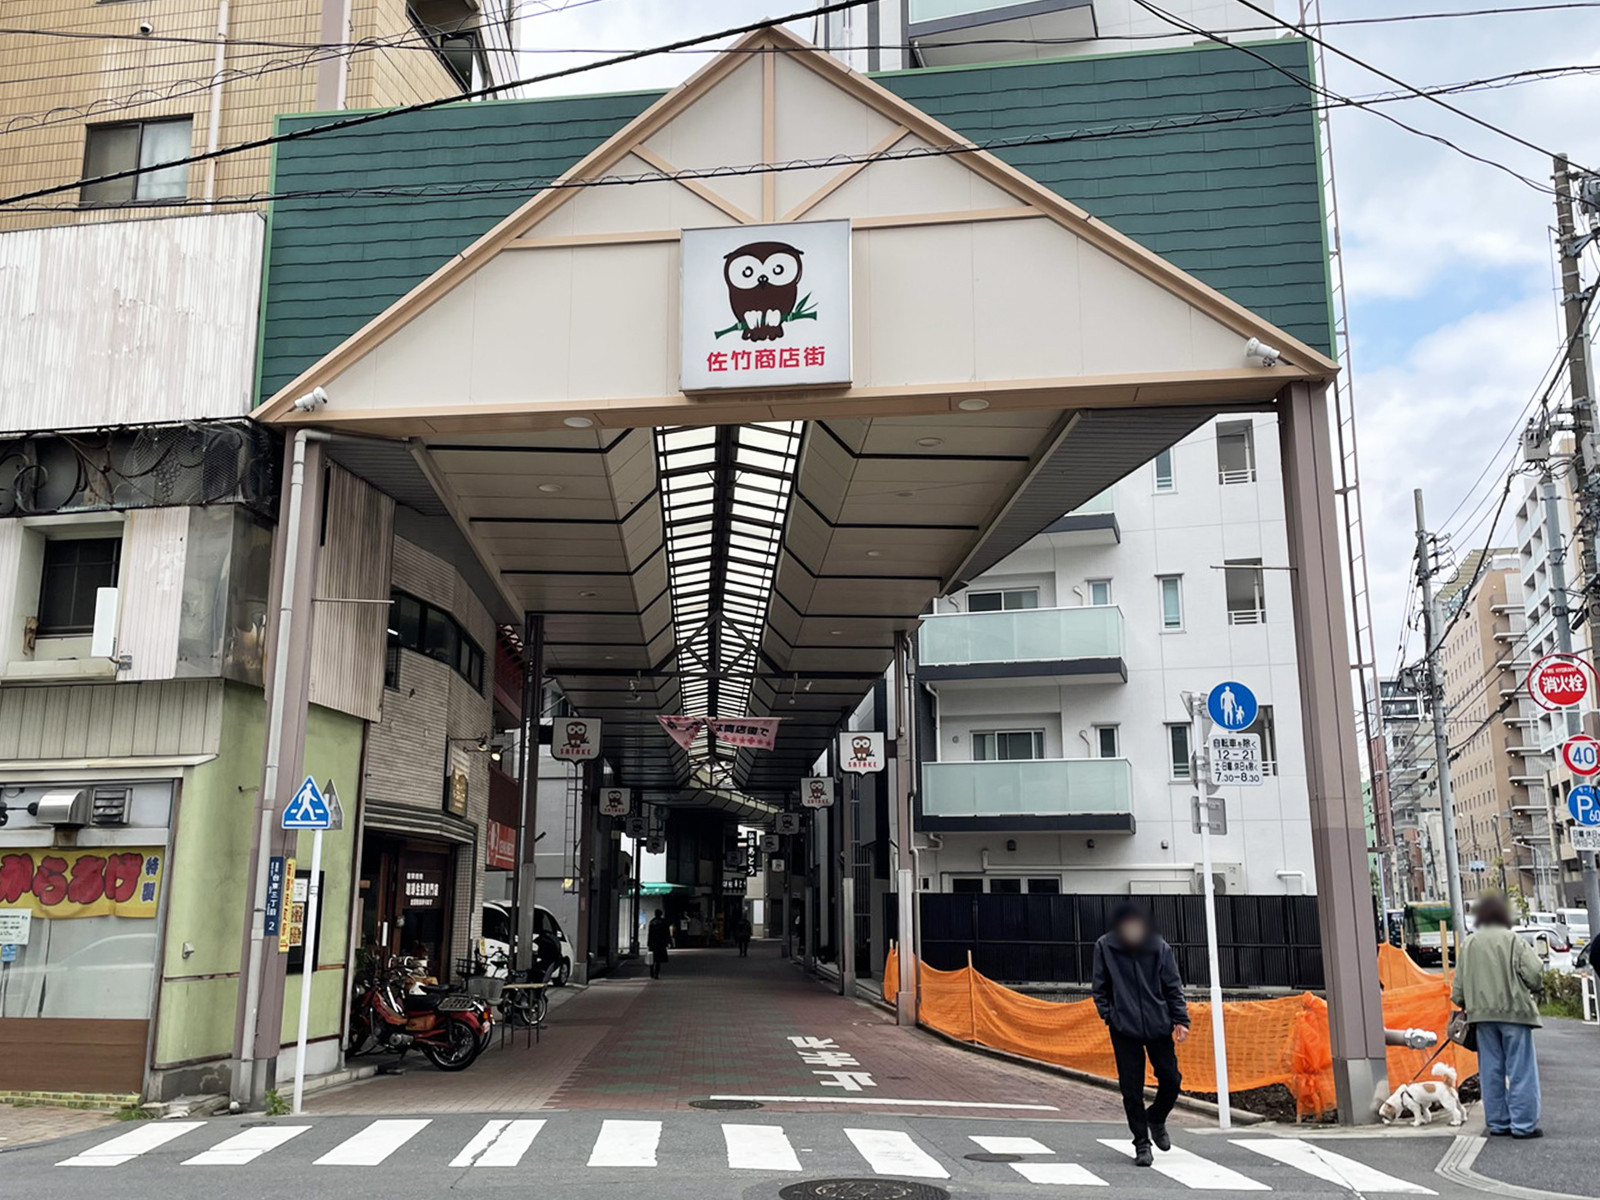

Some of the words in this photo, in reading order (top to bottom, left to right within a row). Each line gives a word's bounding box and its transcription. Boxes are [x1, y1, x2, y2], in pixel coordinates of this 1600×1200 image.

[707, 346, 825, 372] 佐竹商店街
[1541, 674, 1584, 694] 消火栓
[1213, 738, 1257, 749] 自転車を除く
[1573, 747, 1595, 765] 40
[1576, 795, 1593, 822] P
[141, 856, 160, 902] 特製
[268, 921, 276, 931] 2
[787, 1036, 877, 1092] 止まれ
